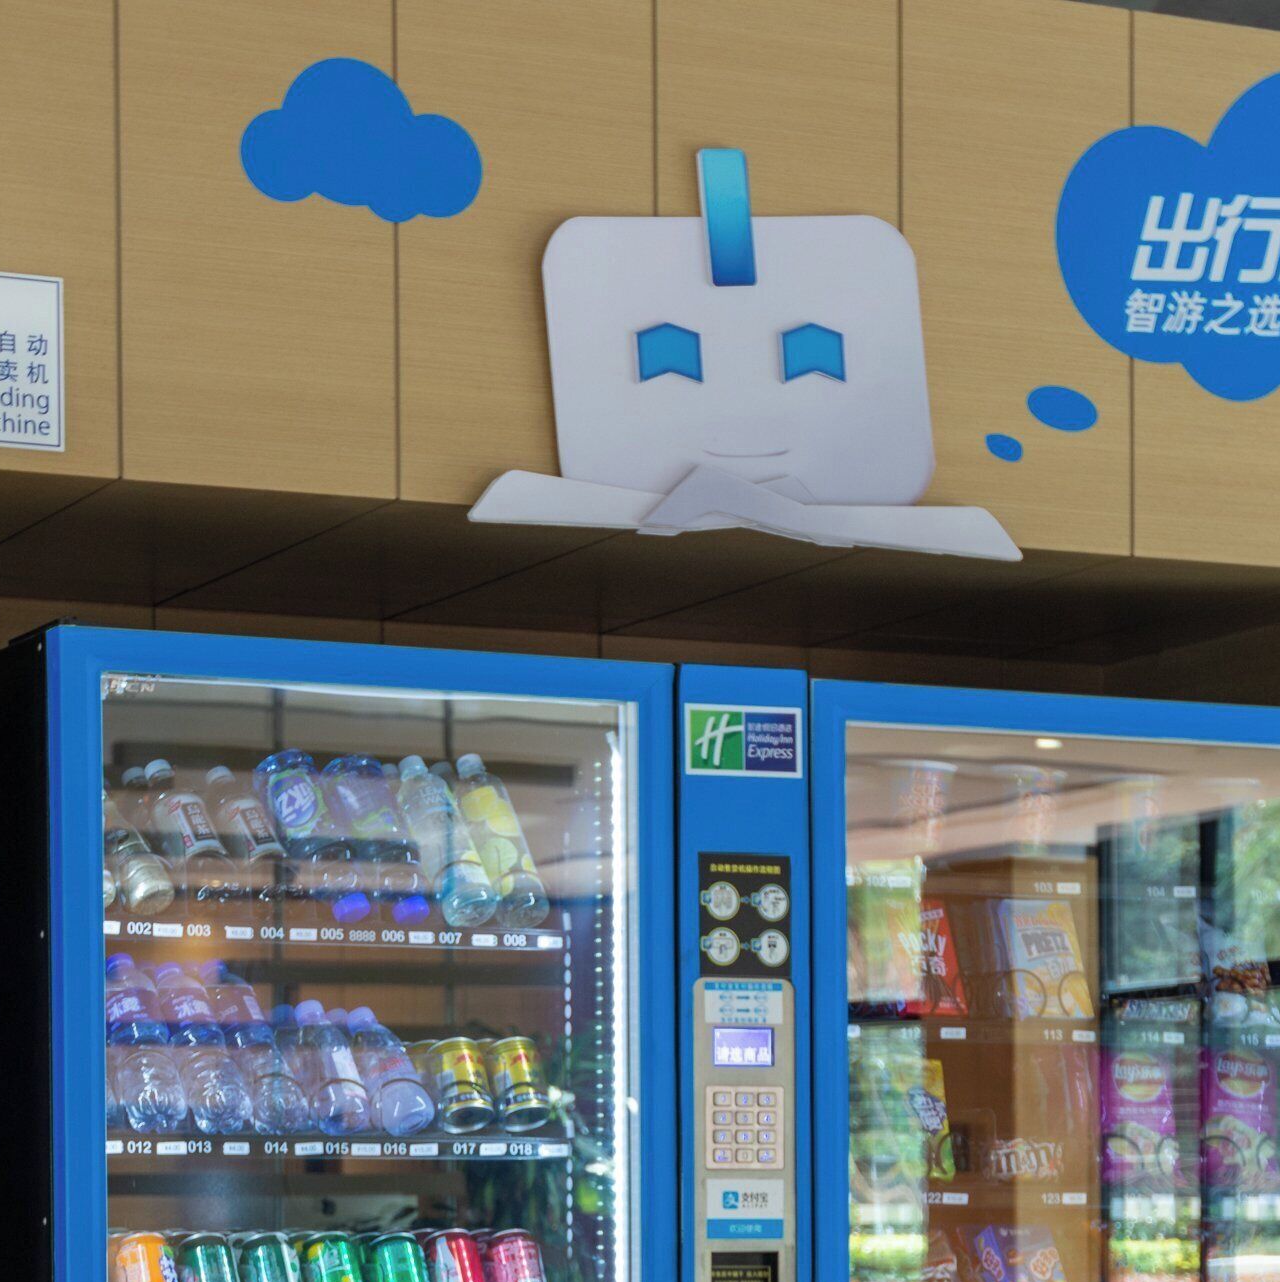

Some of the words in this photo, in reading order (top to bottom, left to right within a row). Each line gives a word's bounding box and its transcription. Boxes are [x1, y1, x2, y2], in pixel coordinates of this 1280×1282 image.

[0, 331, 48, 356] 自动
[747, 734, 779, 746] Holiday
[779, 736, 793, 744] Inn
[747, 744, 793, 761] Express
[127, 922, 151, 935] 002
[187, 924, 211, 936] 003
[261, 927, 284, 939] 004
[321, 928, 344, 941] 005
[382, 930, 405, 942] 006
[439, 932, 462, 944] 007
[503, 934, 526, 946] 008
[127, 1141, 151, 1154] 012
[188, 1140, 212, 1153] 013
[265, 1142, 288, 1154] 014
[326, 1142, 349, 1155] 015
[383, 1143, 407, 1155] 016
[453, 1143, 477, 1154] 017
[510, 1143, 532, 1155] 018
